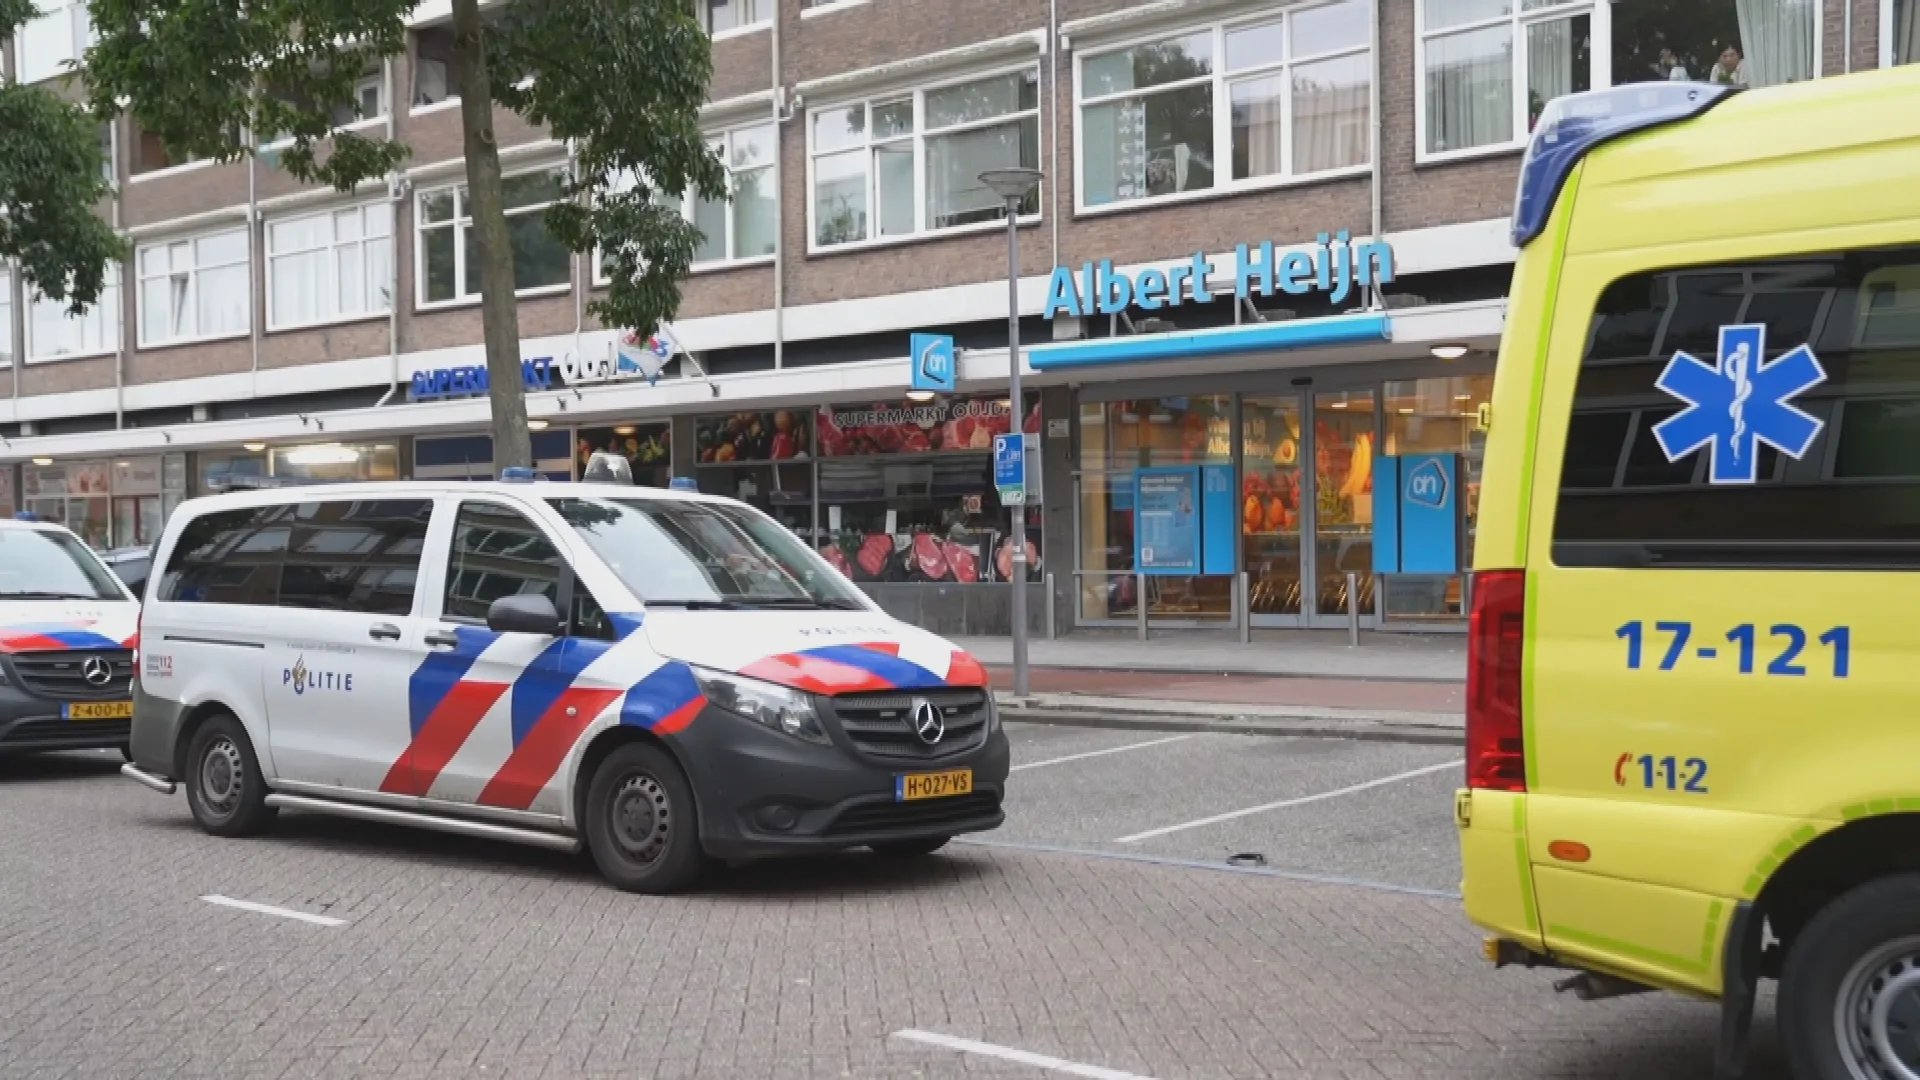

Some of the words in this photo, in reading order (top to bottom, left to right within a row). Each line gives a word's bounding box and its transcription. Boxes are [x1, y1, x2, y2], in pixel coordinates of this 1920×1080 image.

[1043, 250, 1216, 320] Albert
[1234, 228, 1395, 305] Heijn
[835, 405, 947, 429] SUPERMARKT
[996, 438, 1007, 461] P
[1615, 619, 1851, 679] 17-121
[282, 667, 353, 695] POLITIE
[72, 703, 132, 718] Z-400-PL
[907, 773, 968, 797] H-027-VS
